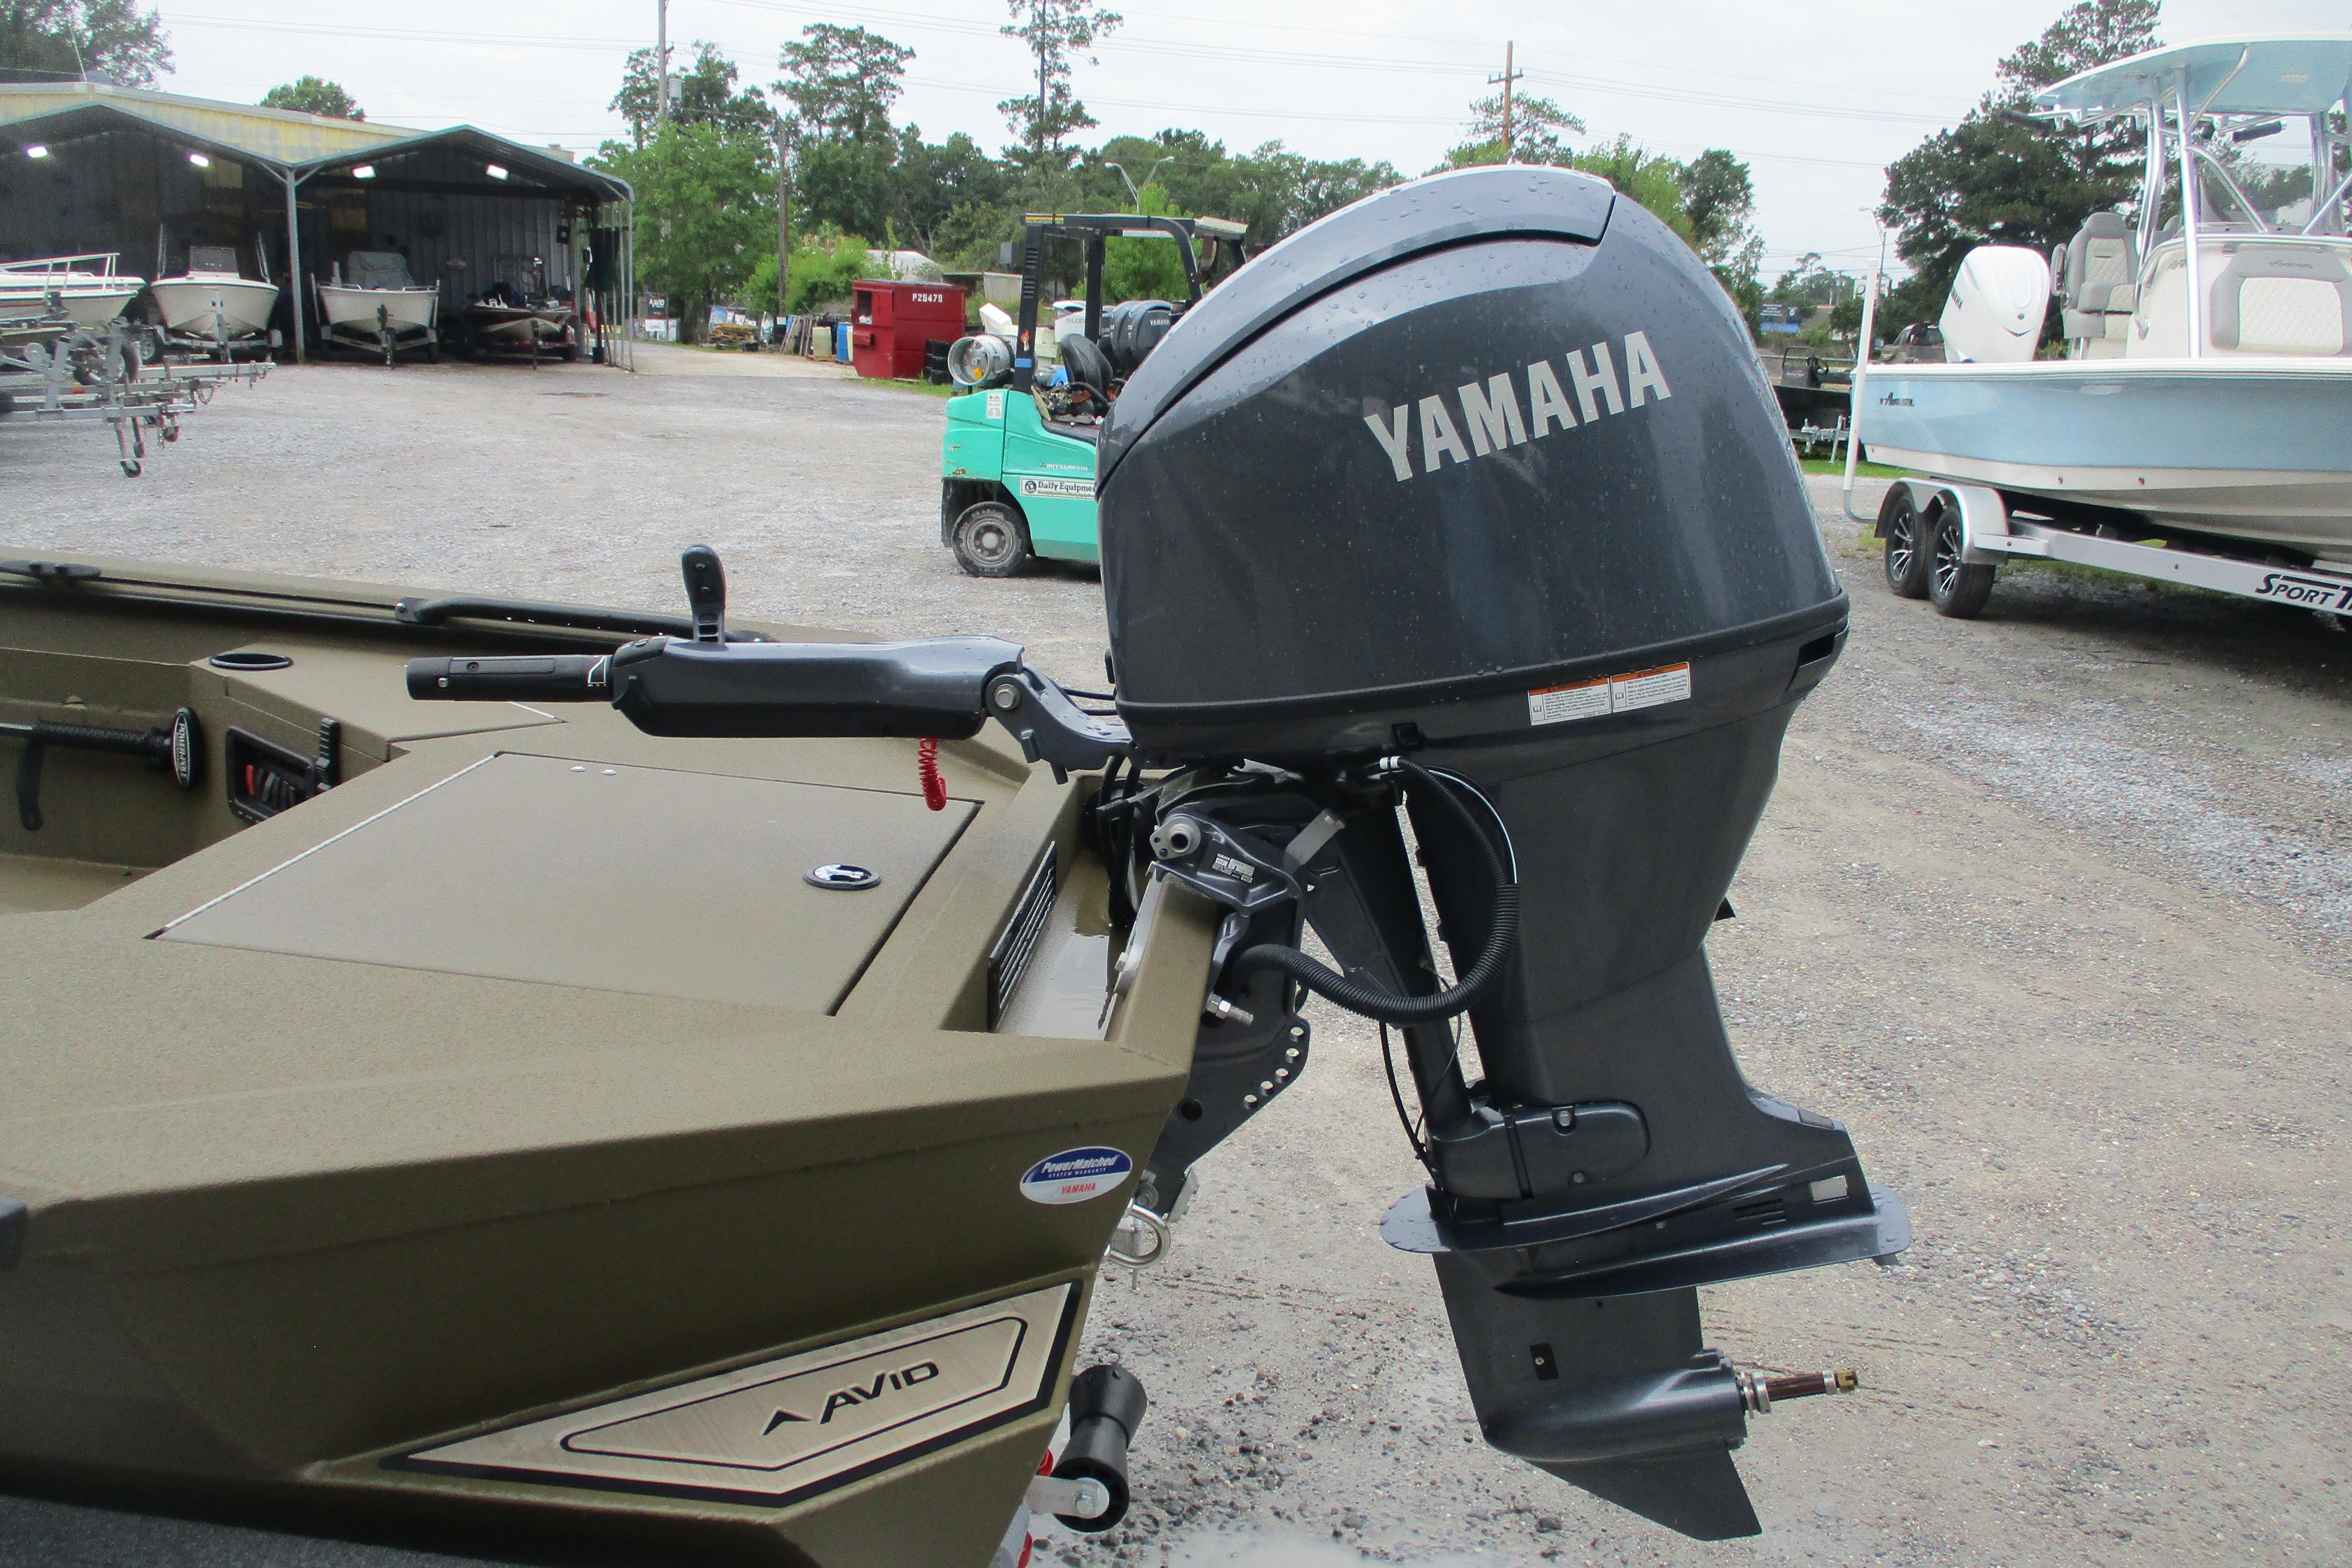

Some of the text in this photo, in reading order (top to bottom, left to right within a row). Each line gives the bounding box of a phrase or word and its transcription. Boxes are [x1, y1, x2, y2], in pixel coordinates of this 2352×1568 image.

[912, 293, 943, 303] P25479
[1364, 330, 1671, 482] YAMAHA
[1046, 463, 1088, 472] MITSUBISHI
[1038, 481, 1058, 491] Daily
[2255, 573, 2336, 605] SPORT
[1041, 1154, 1118, 1174] PowerMatched
[1075, 1167, 1107, 1175] WARRANTY
[1060, 1182, 1096, 1195] YAMAHA
[820, 1360, 940, 1425] AVID
